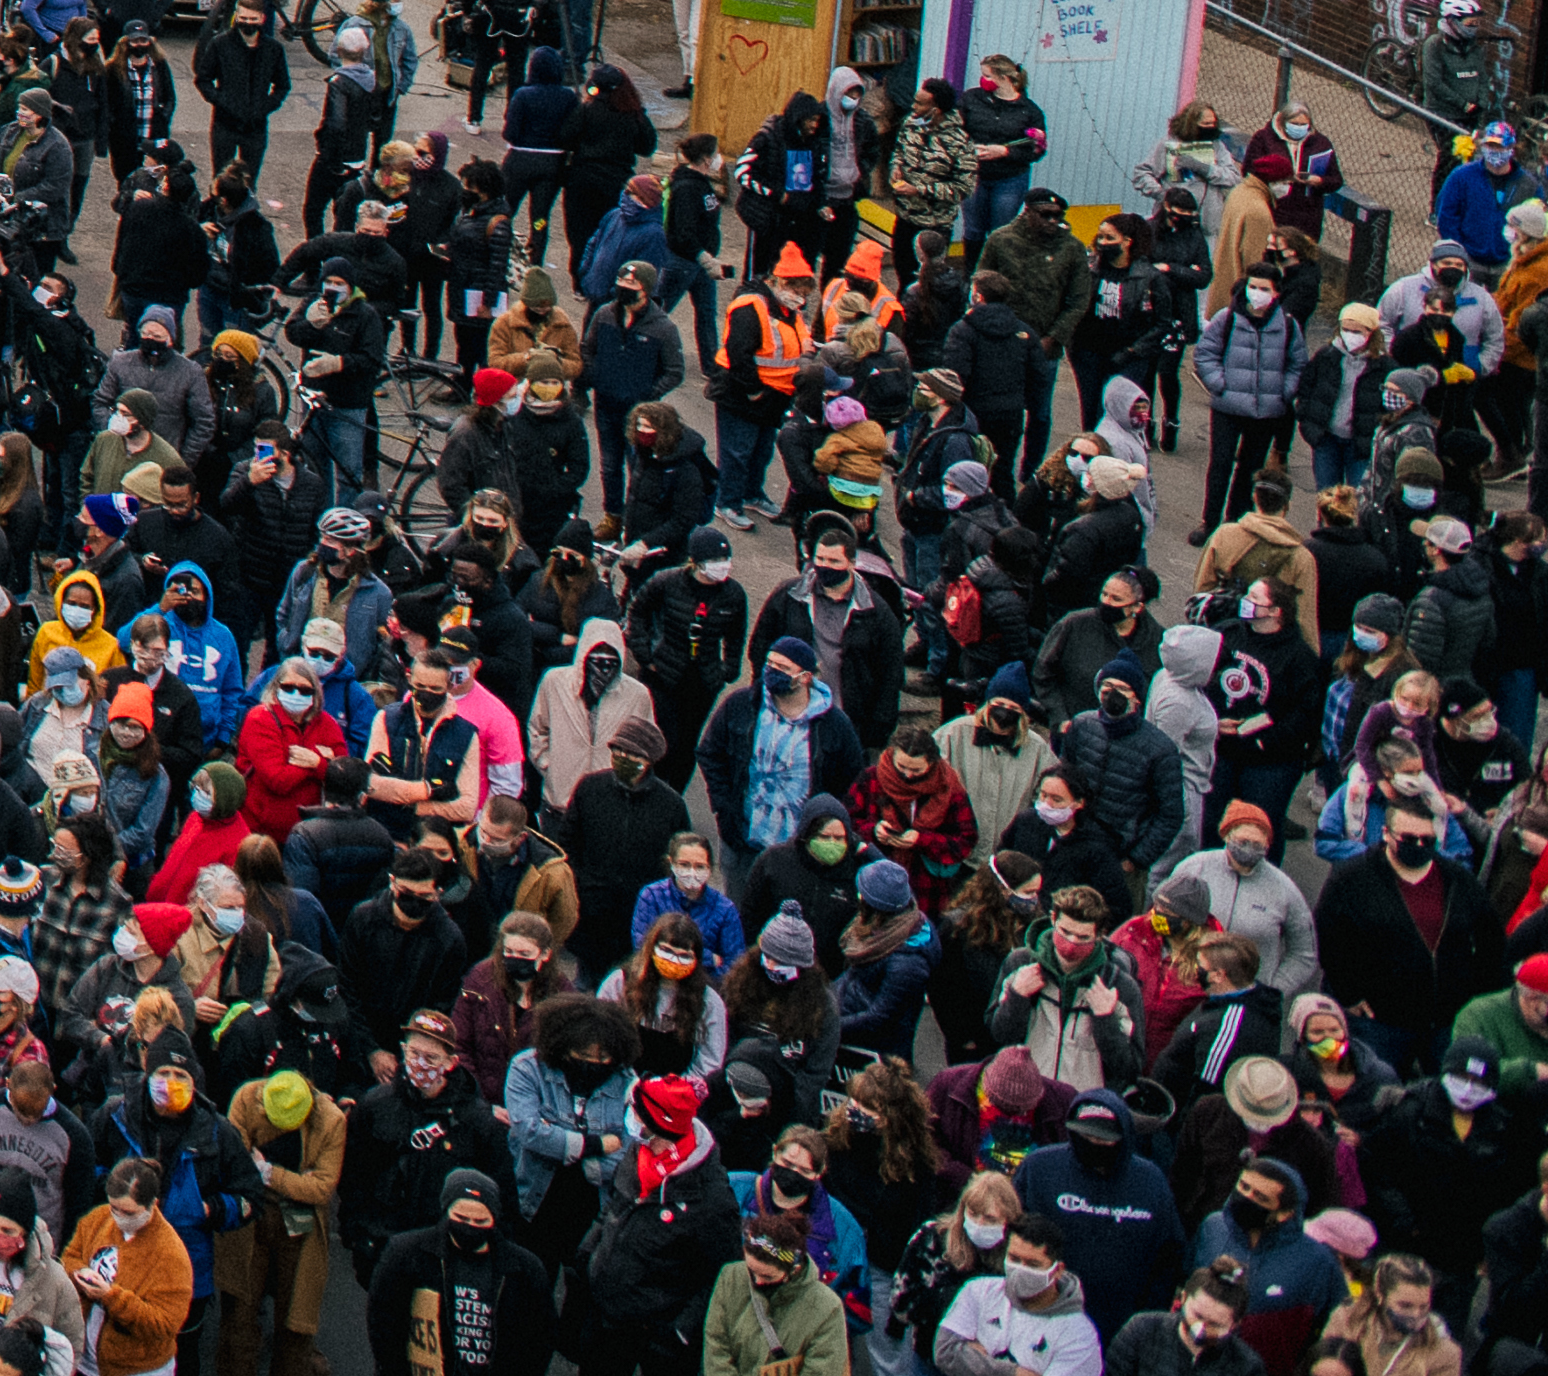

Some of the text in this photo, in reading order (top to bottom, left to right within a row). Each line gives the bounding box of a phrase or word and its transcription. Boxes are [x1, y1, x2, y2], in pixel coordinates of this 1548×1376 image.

[1058, 5, 1095, 21] BOOK
[1060, 20, 1102, 38] SHELF
[1057, 1193, 1151, 1222] Champion
